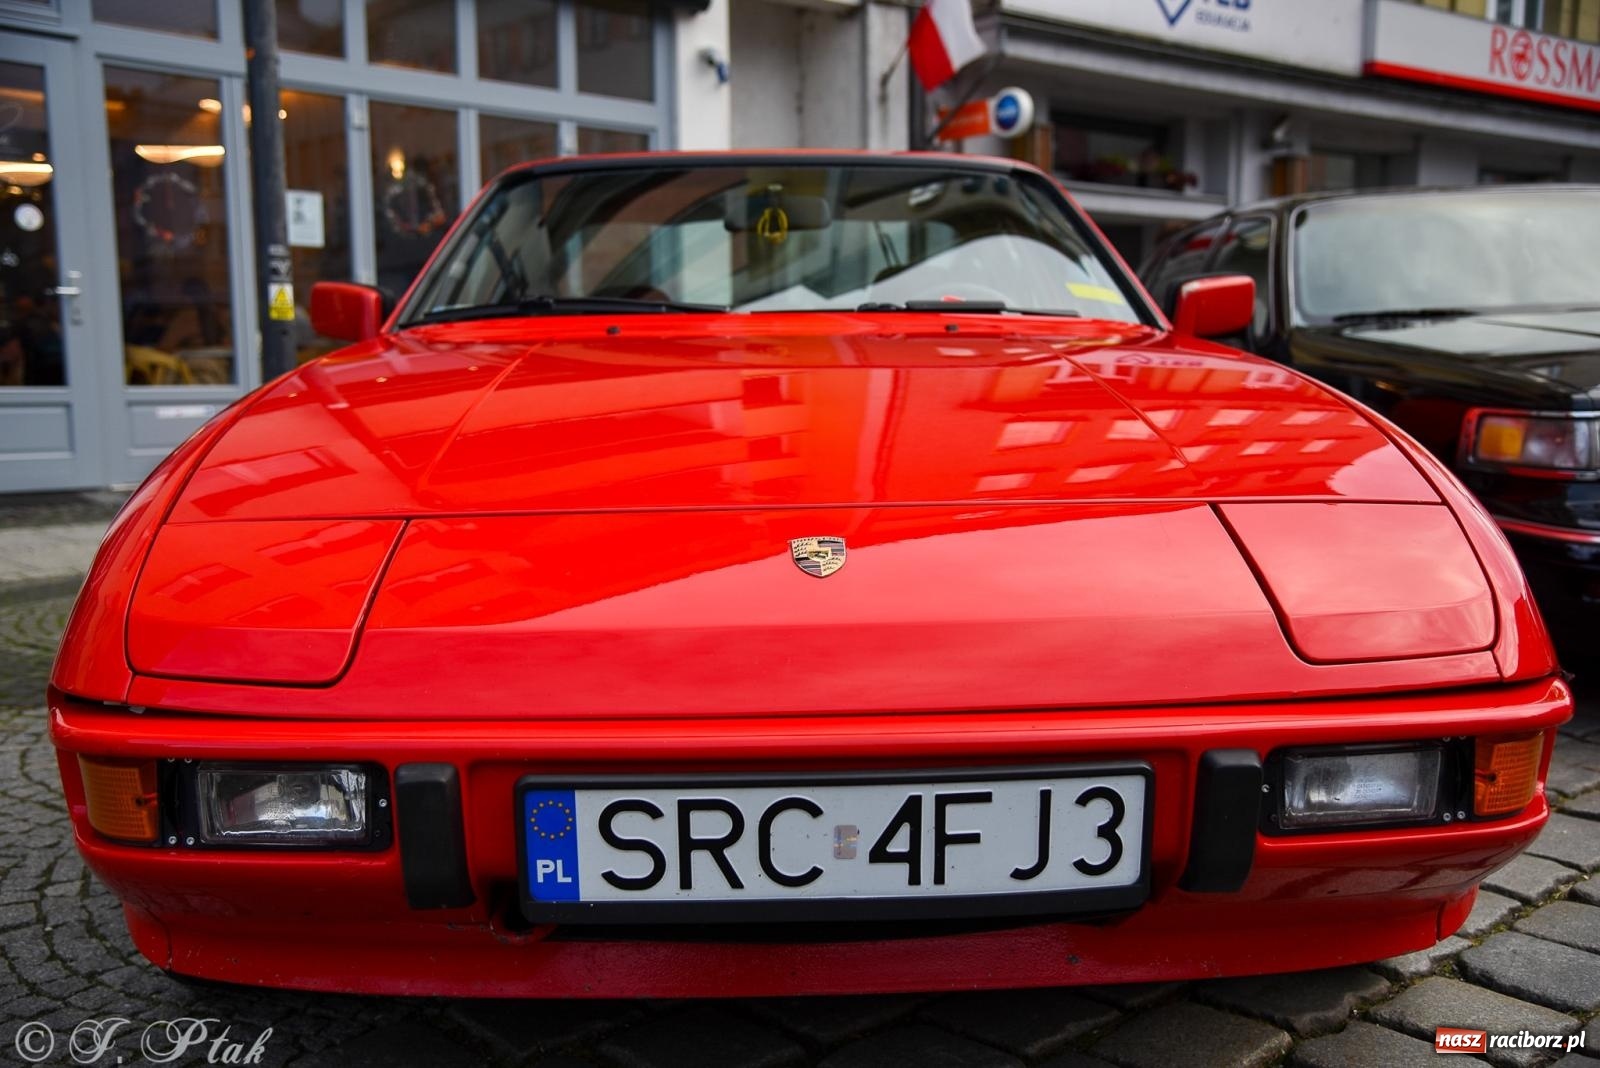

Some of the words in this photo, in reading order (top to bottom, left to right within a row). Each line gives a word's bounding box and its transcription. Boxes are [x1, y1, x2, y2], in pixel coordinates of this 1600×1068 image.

[1489, 25, 1600, 93] ROSSM
[536, 859, 572, 883] PL
[598, 796, 825, 891] SRC
